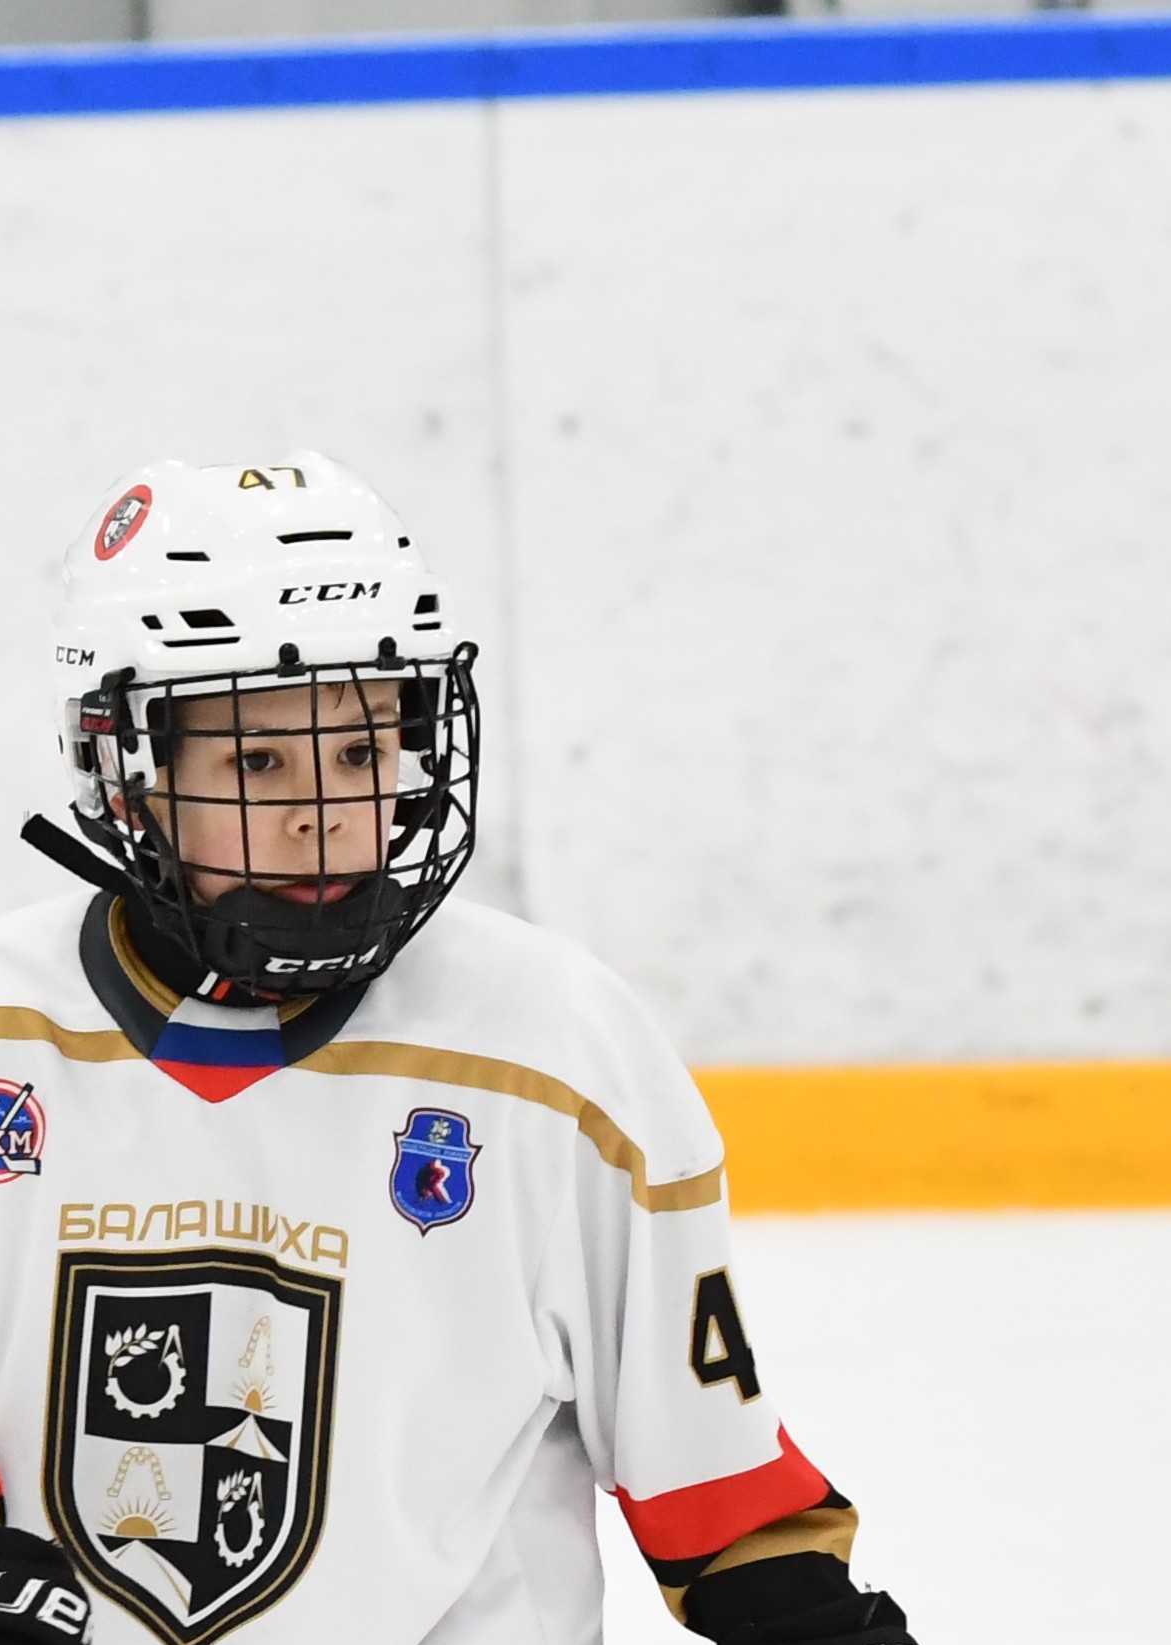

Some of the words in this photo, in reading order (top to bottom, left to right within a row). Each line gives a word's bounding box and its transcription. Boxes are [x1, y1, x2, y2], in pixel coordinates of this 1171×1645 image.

[238, 466, 307, 490] 47
[278, 581, 382, 605] CCM
[56, 645, 95, 667] CCM
